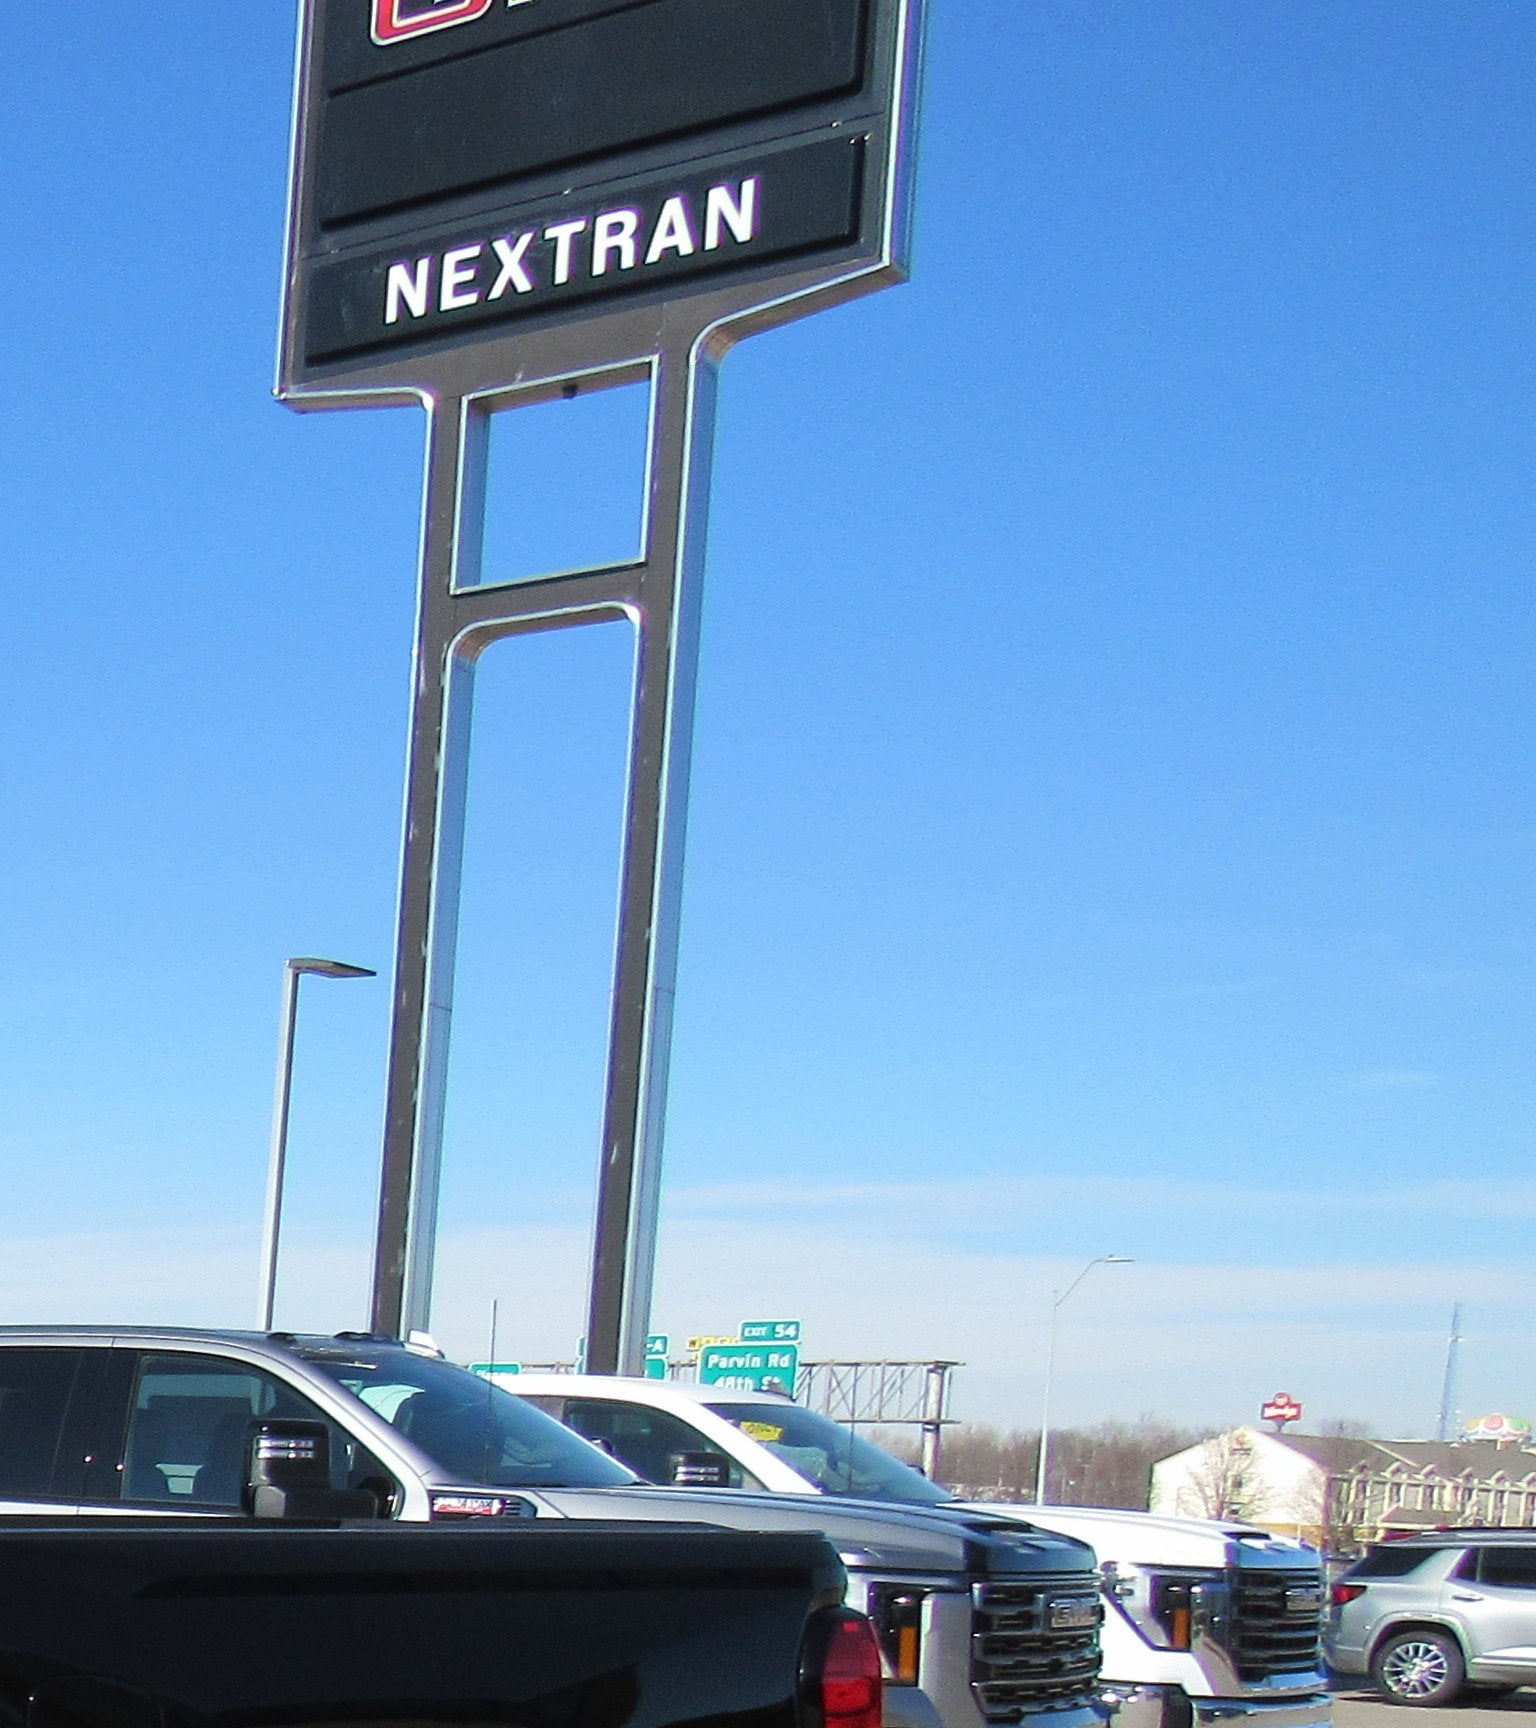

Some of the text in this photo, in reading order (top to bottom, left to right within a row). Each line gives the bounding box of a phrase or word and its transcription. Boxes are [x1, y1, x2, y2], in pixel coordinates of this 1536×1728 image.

[384, 177, 758, 325] NEXTRAN
[774, 1323, 797, 1338] 54
[707, 1353, 791, 1369] Parvin Rd
